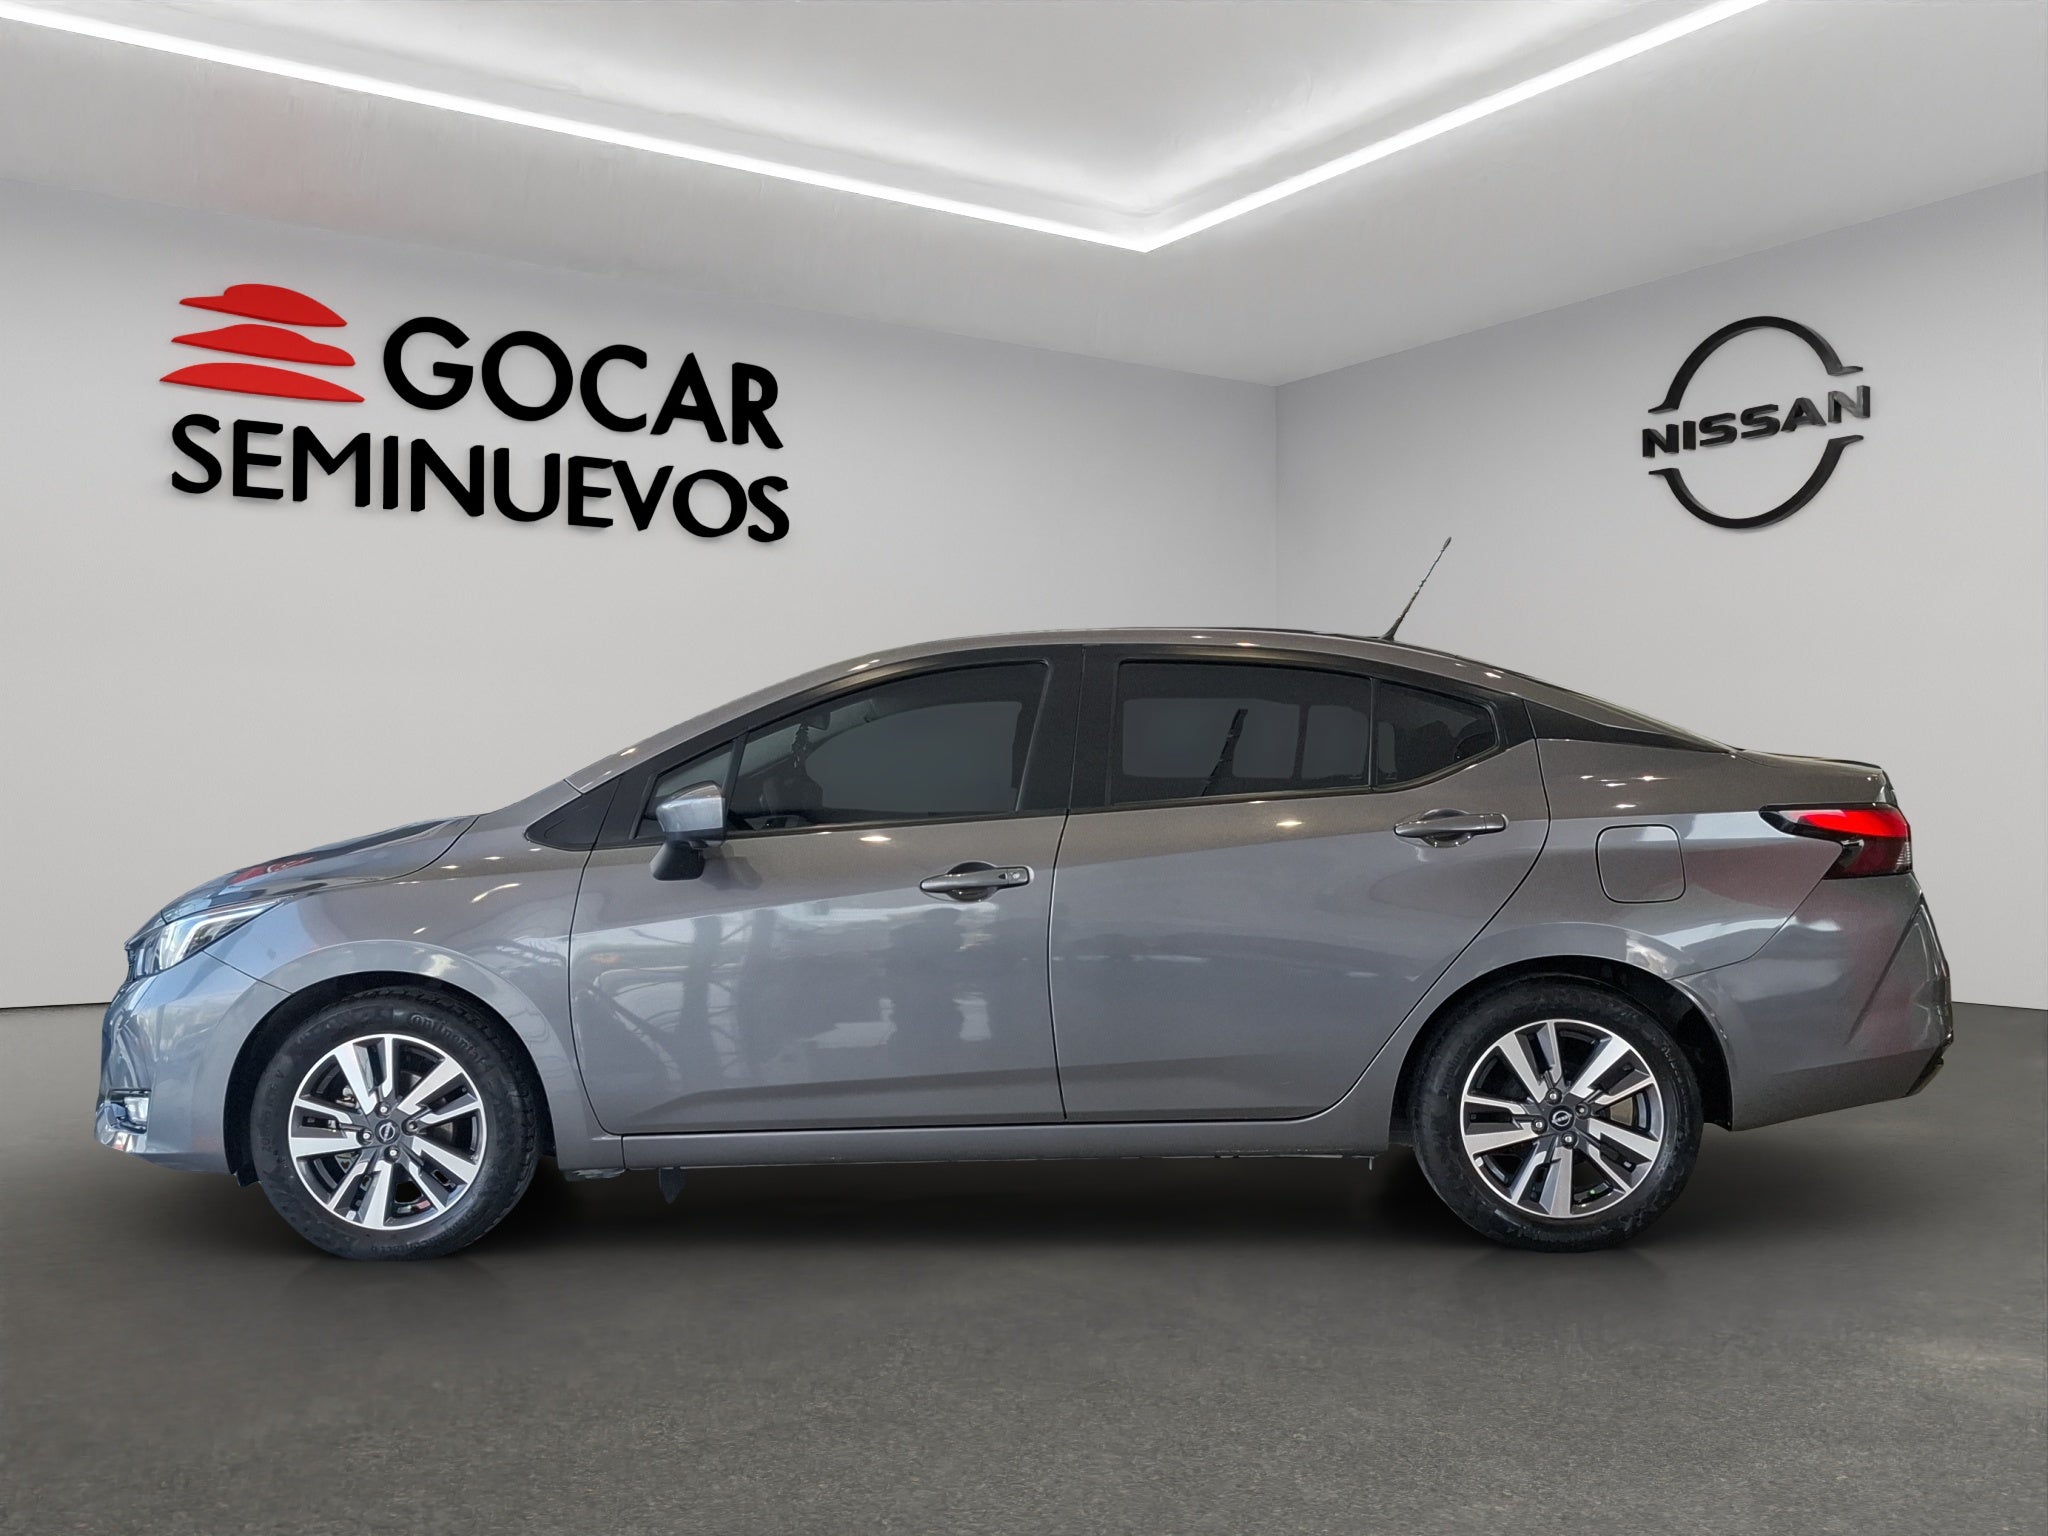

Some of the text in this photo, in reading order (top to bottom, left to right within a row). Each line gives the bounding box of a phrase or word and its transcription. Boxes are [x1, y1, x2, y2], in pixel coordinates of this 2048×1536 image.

[382, 315, 784, 450] GOCAR
[1642, 385, 1871, 459] NISSAN
[171, 413, 790, 543] SEMINUEVOS
